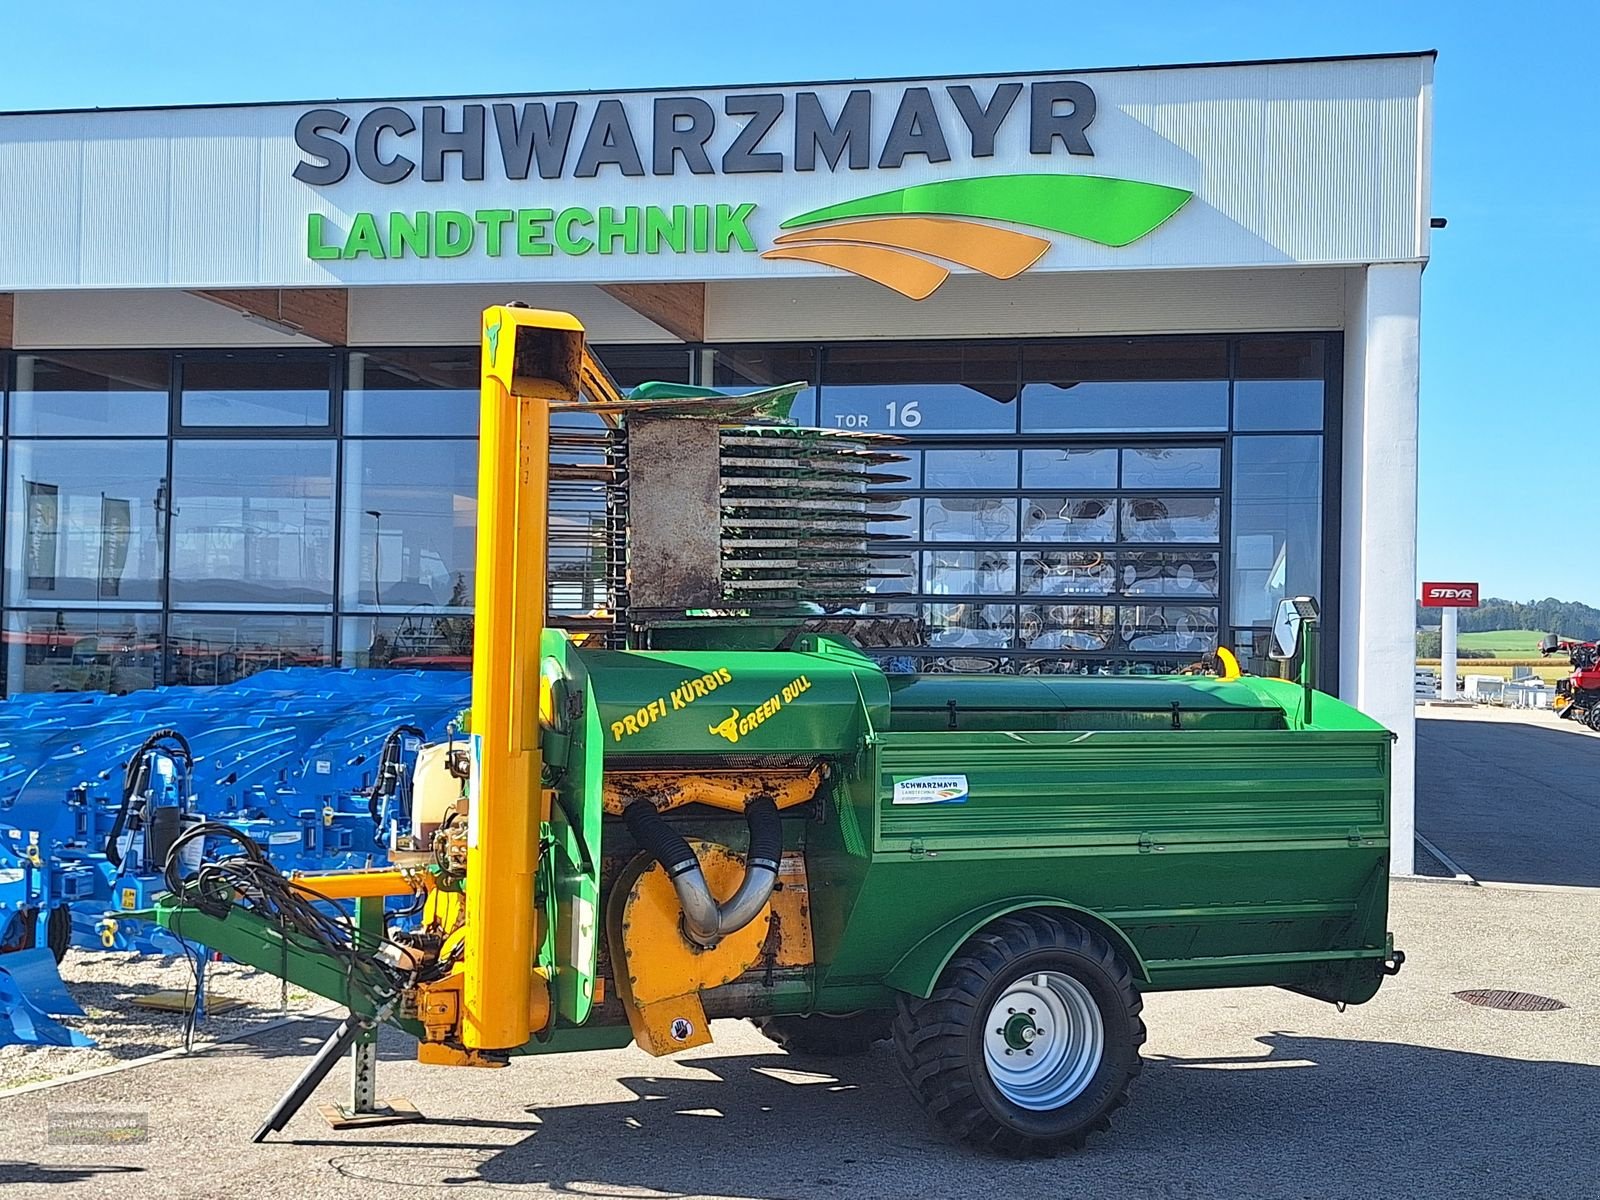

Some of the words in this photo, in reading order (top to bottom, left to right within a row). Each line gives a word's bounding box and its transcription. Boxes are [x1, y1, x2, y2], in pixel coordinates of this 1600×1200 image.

[292, 80, 1097, 186] SCHWARZMAYR
[307, 202, 758, 260] LANDTECHNIK
[835, 414, 869, 427] TOR
[886, 401, 922, 428] 16
[1428, 588, 1473, 598] STEYR
[611, 697, 668, 742] PROFI
[670, 667, 732, 710] KÜRBIS
[738, 694, 781, 736] GREEN
[781, 675, 812, 704] BULL
